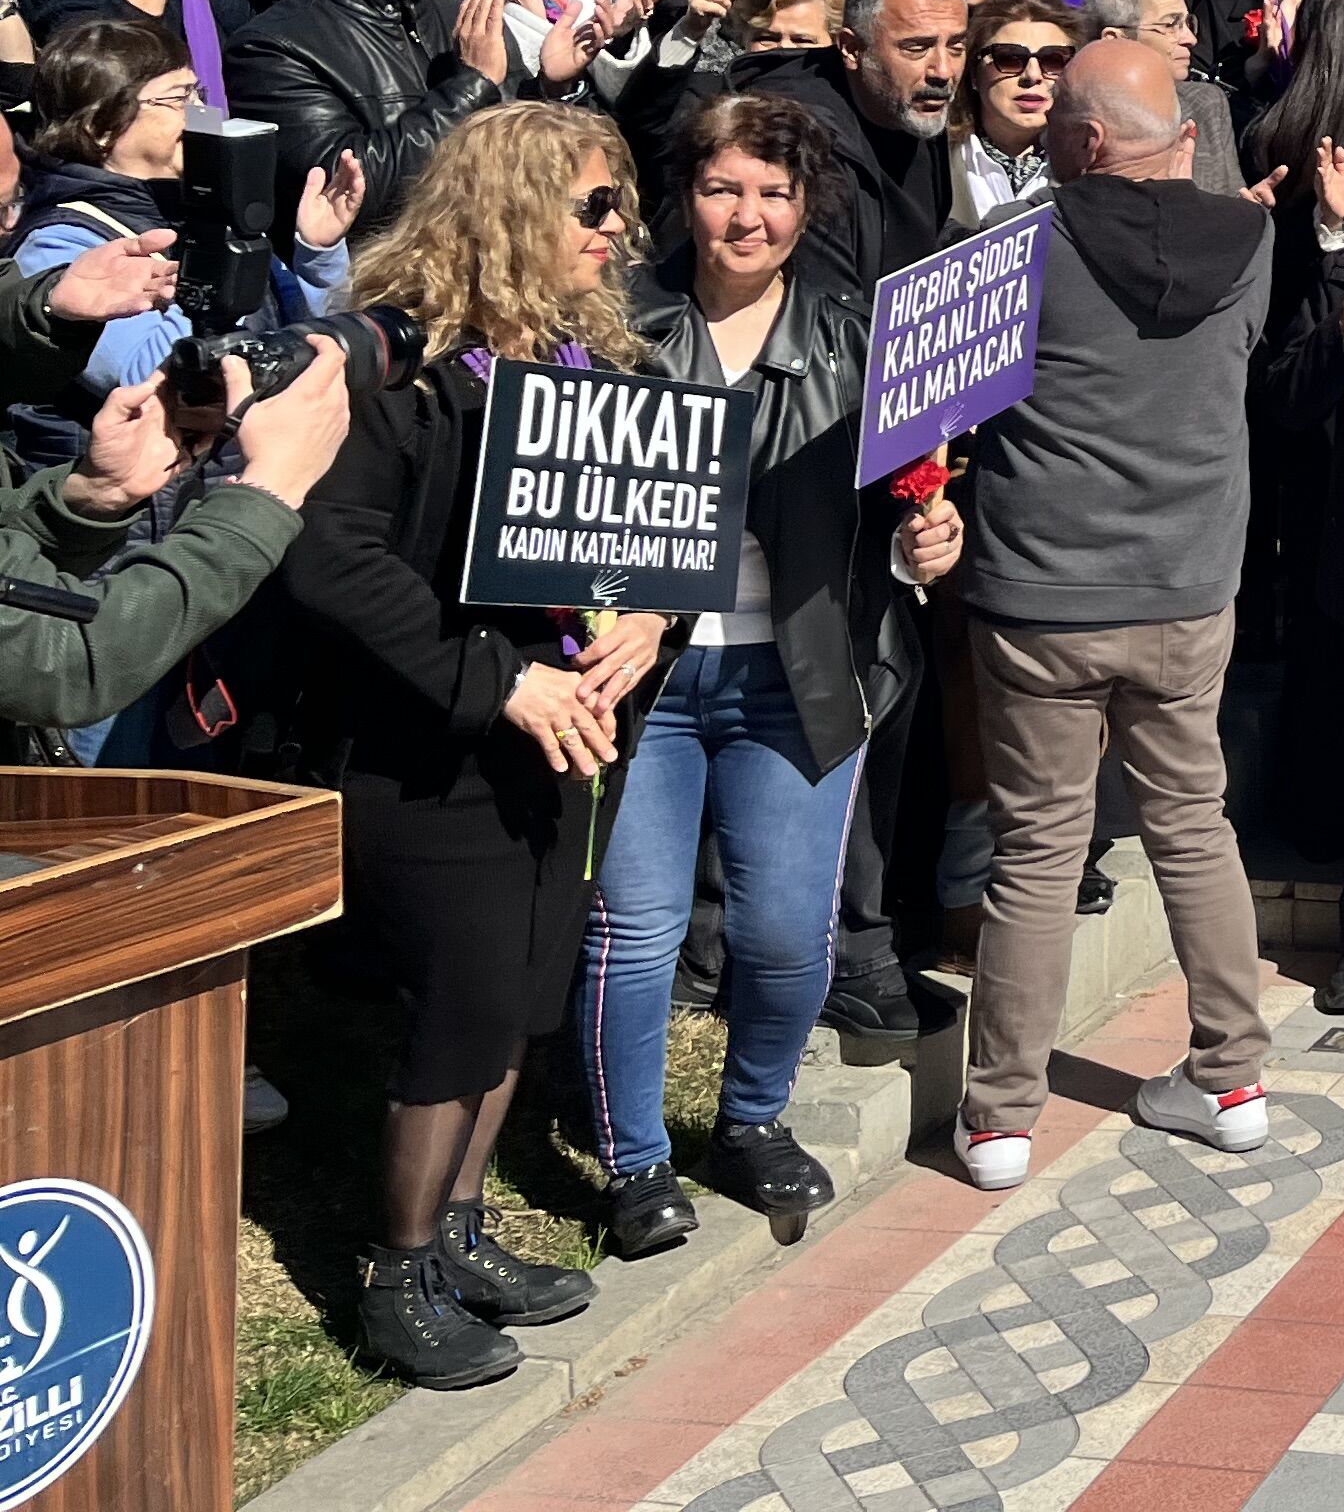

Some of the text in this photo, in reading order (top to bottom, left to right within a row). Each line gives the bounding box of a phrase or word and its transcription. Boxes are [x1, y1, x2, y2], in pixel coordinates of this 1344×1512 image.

[882, 274, 1028, 383] KARANLIKTA
[888, 223, 1039, 330] HİÇBİR ŞİDDET
[878, 320, 1026, 434] KALMAYACAK
[498, 524, 567, 562] KADIN
[672, 536, 718, 571] VAR!
[506, 464, 721, 531] BU ÜLKEDE
